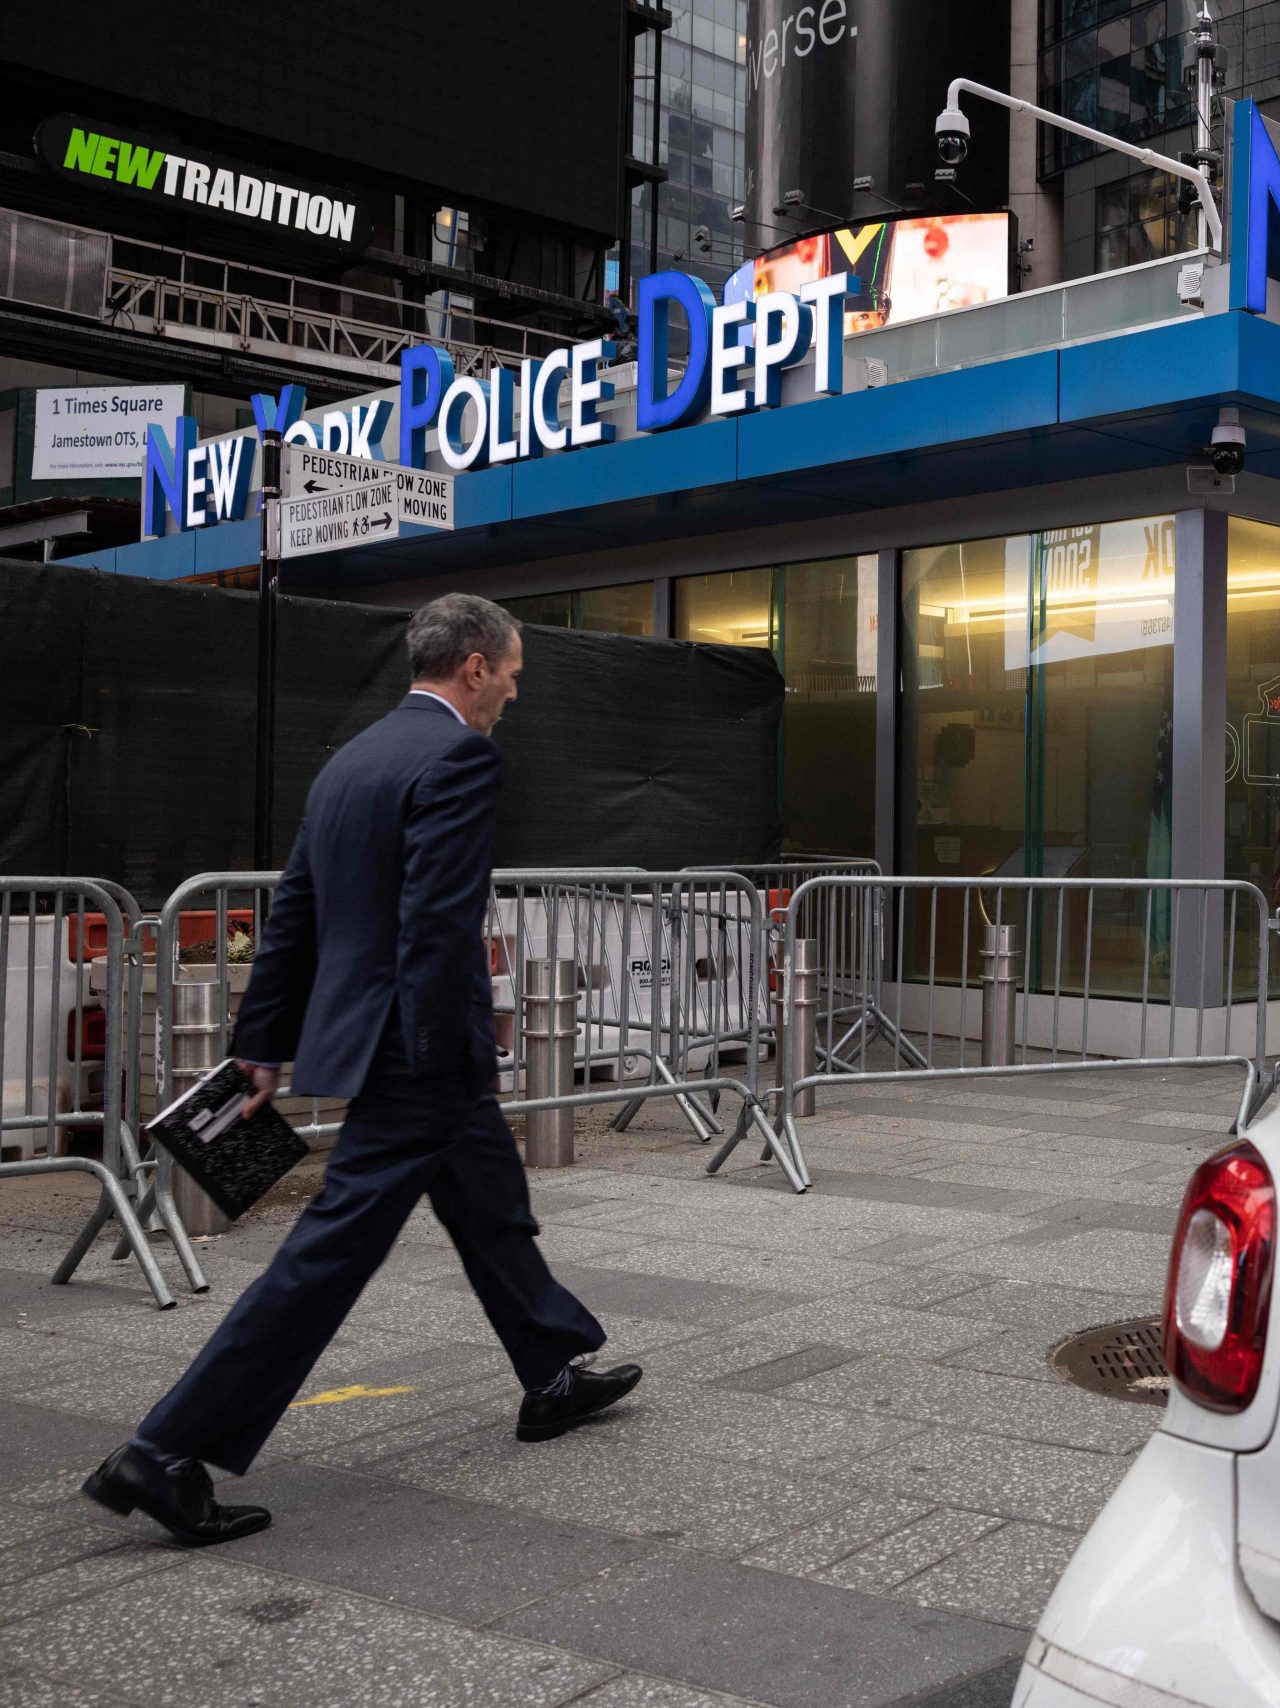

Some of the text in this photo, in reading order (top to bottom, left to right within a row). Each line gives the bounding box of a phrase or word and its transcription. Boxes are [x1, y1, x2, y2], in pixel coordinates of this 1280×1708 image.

[52, 396, 163, 416] 1 Times Square
[145, 415, 251, 537] NEW
[401, 344, 614, 471] POLICE
[637, 270, 858, 432] DEPT
[51, 432, 112, 448] Jamestown
[114, 431, 140, 448] OTS,
[302, 454, 379, 483] PEDESTRIAN
[417, 477, 447, 498] ZONE
[289, 484, 393, 524] PEDESTRIAN FLOW ZONE
[404, 497, 447, 520] MOVING
[290, 520, 349, 548] KEEP MOVING
